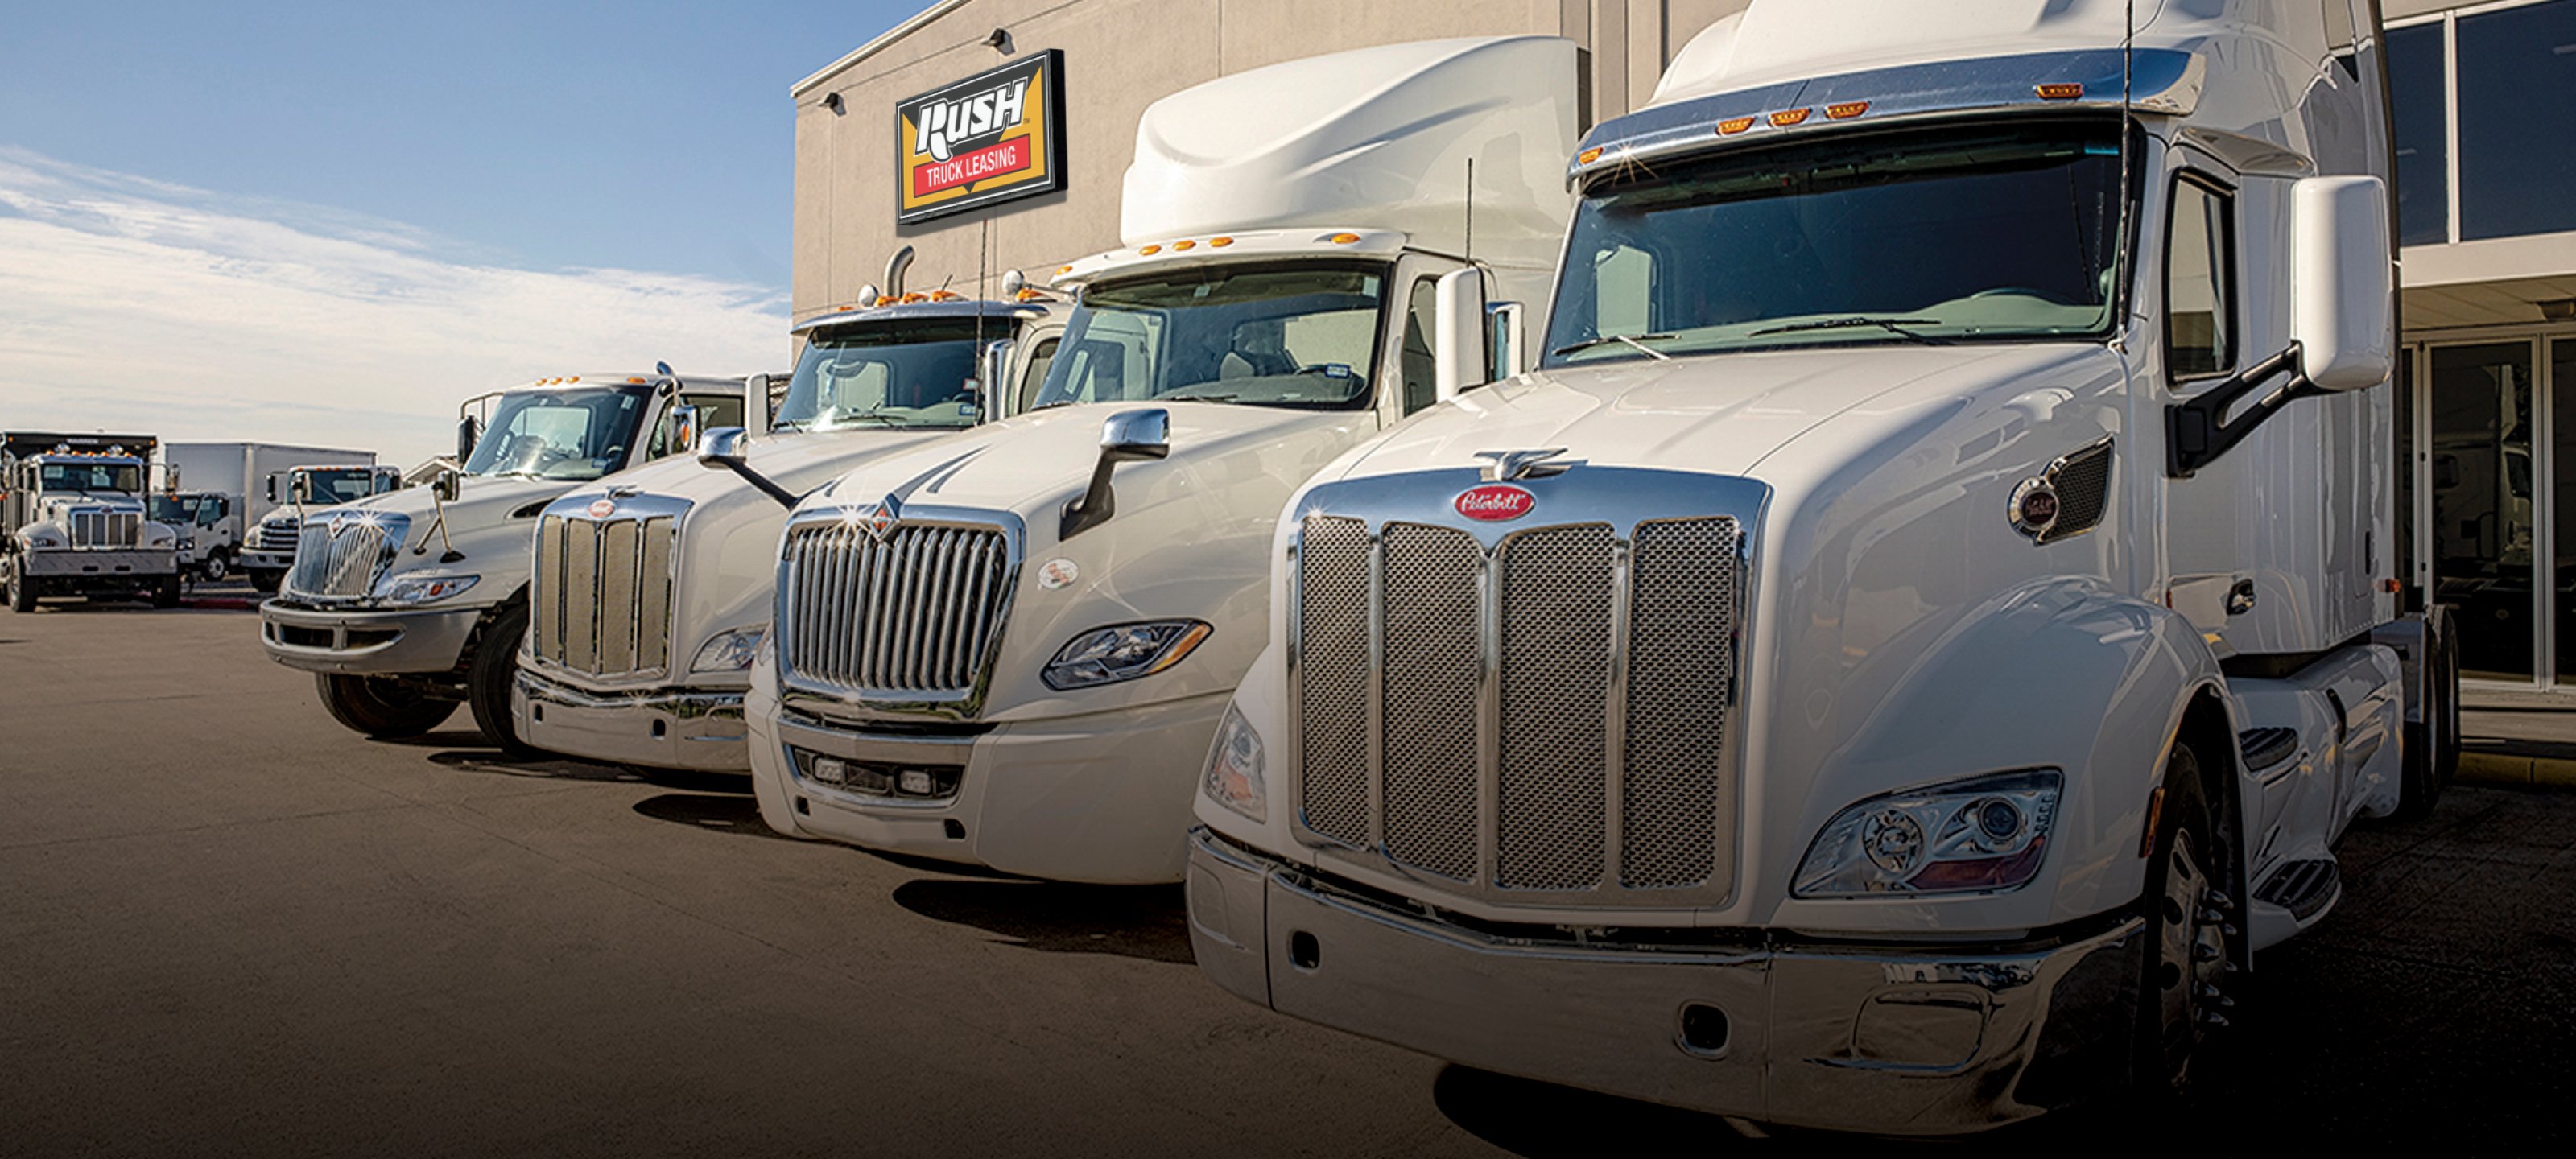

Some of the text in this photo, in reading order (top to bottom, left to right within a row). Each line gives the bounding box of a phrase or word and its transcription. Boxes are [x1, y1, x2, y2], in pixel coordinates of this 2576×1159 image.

[914, 78, 1027, 163] RUSH
[927, 146, 1017, 188] TRUCK LEASING
[1461, 492, 1526, 512] Peterbilt
